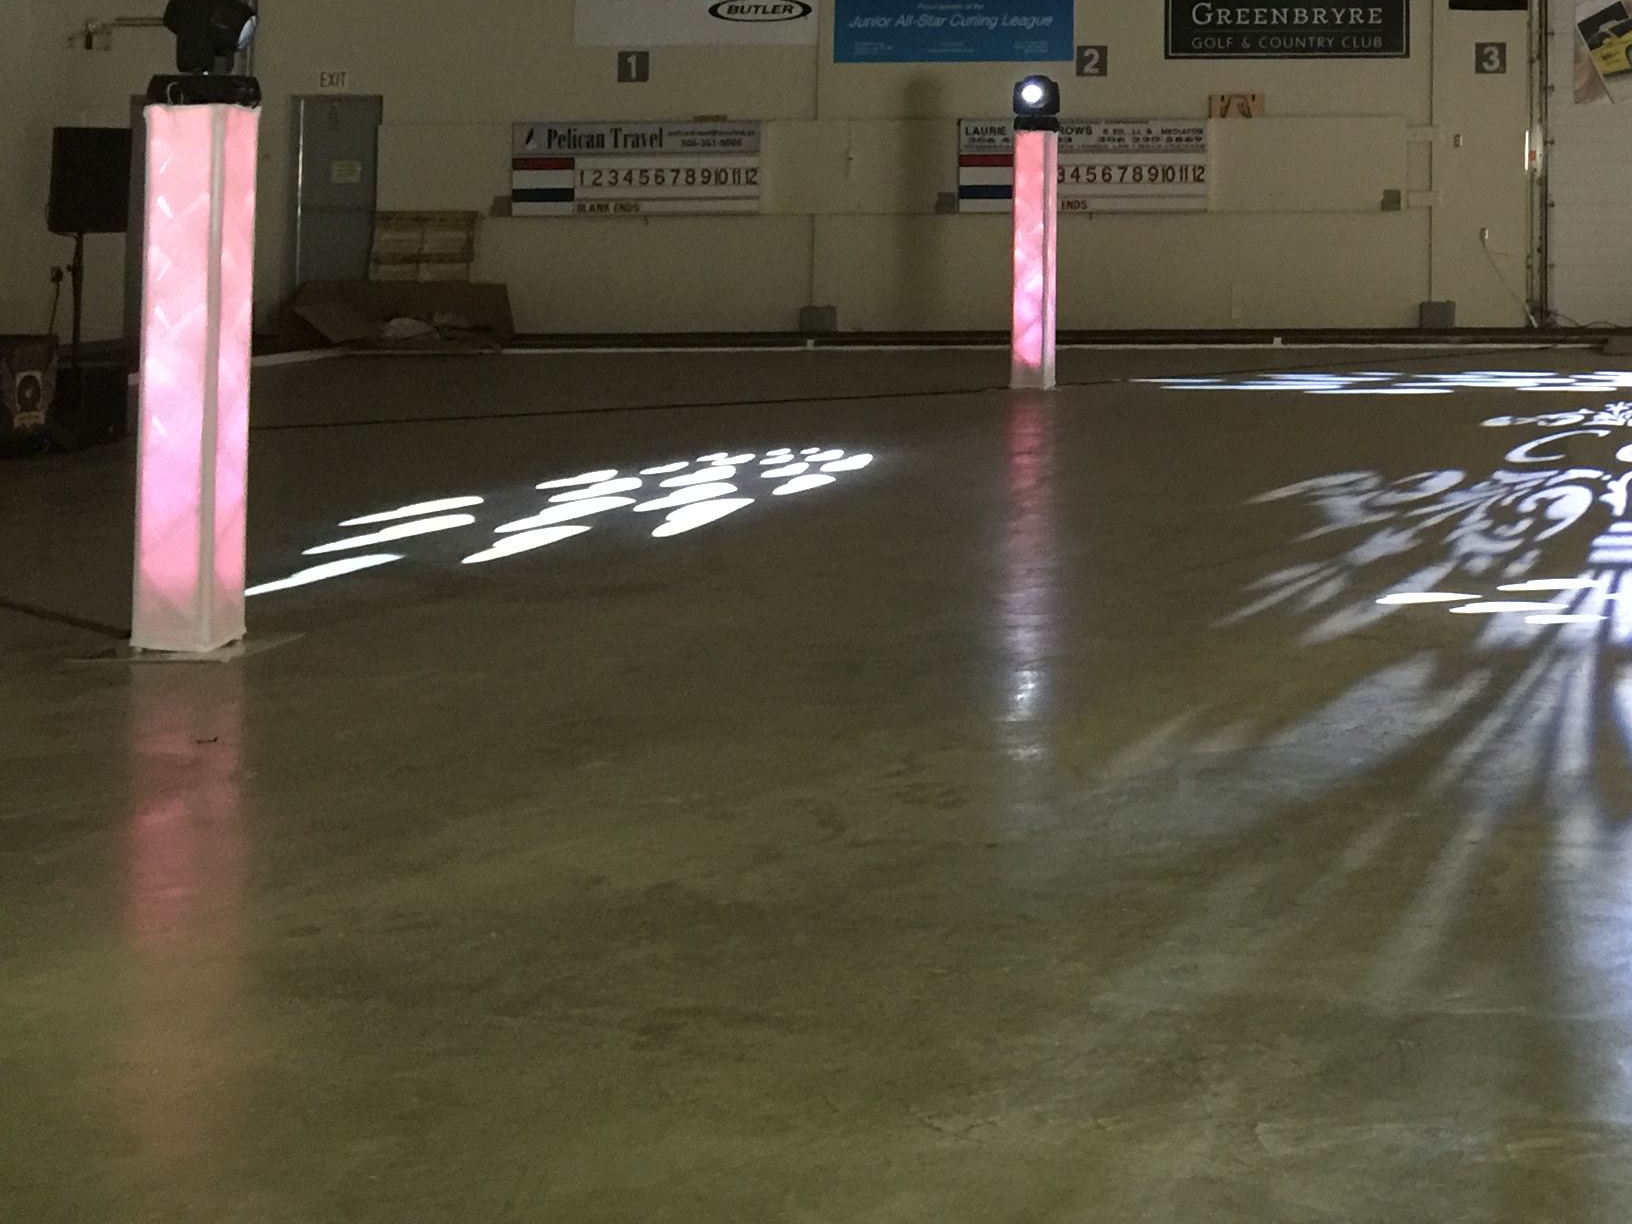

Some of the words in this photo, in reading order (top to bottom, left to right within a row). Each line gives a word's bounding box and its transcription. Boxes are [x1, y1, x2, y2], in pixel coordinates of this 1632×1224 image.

[726, 4, 794, 16] BUTLER
[1191, 2, 1383, 25] GREENBRYRE
[849, 13, 892, 28] Junior
[895, 13, 947, 27] All-Star
[950, 14, 999, 30] Curling
[1001, 14, 1053, 30] League
[1192, 37, 1234, 49] GOLF
[1241, 36, 1250, 49] &
[1259, 36, 1334, 49] COUNTRY
[1341, 36, 1383, 49] CLUB
[627, 55, 637, 79] 1
[1083, 48, 1100, 74] 2
[1483, 46, 1500, 71] 3
[320, 71, 347, 87] EXIT
[547, 128, 605, 150] Pelican
[609, 127, 663, 150] Travel
[965, 126, 1007, 135] LAURIE
[579, 168, 585, 186] 1
[592, 168, 603, 186] 2
[607, 168, 619, 186] 3
[622, 168, 634, 186] 4
[638, 168, 650, 186] 5
[653, 168, 665, 186] 6
[670, 168, 681, 186] 7
[685, 168, 696, 186] 8
[700, 168, 711, 186] 9
[714, 168, 728, 186] 10
[731, 168, 741, 186] 11
[744, 168, 758, 186] 12
[1070, 165, 1080, 183] 4
[1086, 165, 1097, 183] 5
[1101, 165, 1113, 183] 6
[1117, 165, 1129, 183] 7
[1131, 165, 1144, 183] 8
[1148, 165, 1159, 183] 9
[1161, 165, 1176, 183] 10
[1178, 165, 1188, 183] 11
[1192, 165, 1205, 183] 12
[614, 203, 640, 213] ENDS
[1061, 199, 1089, 210] ENDS
[1504, 428, 1611, 463] C
